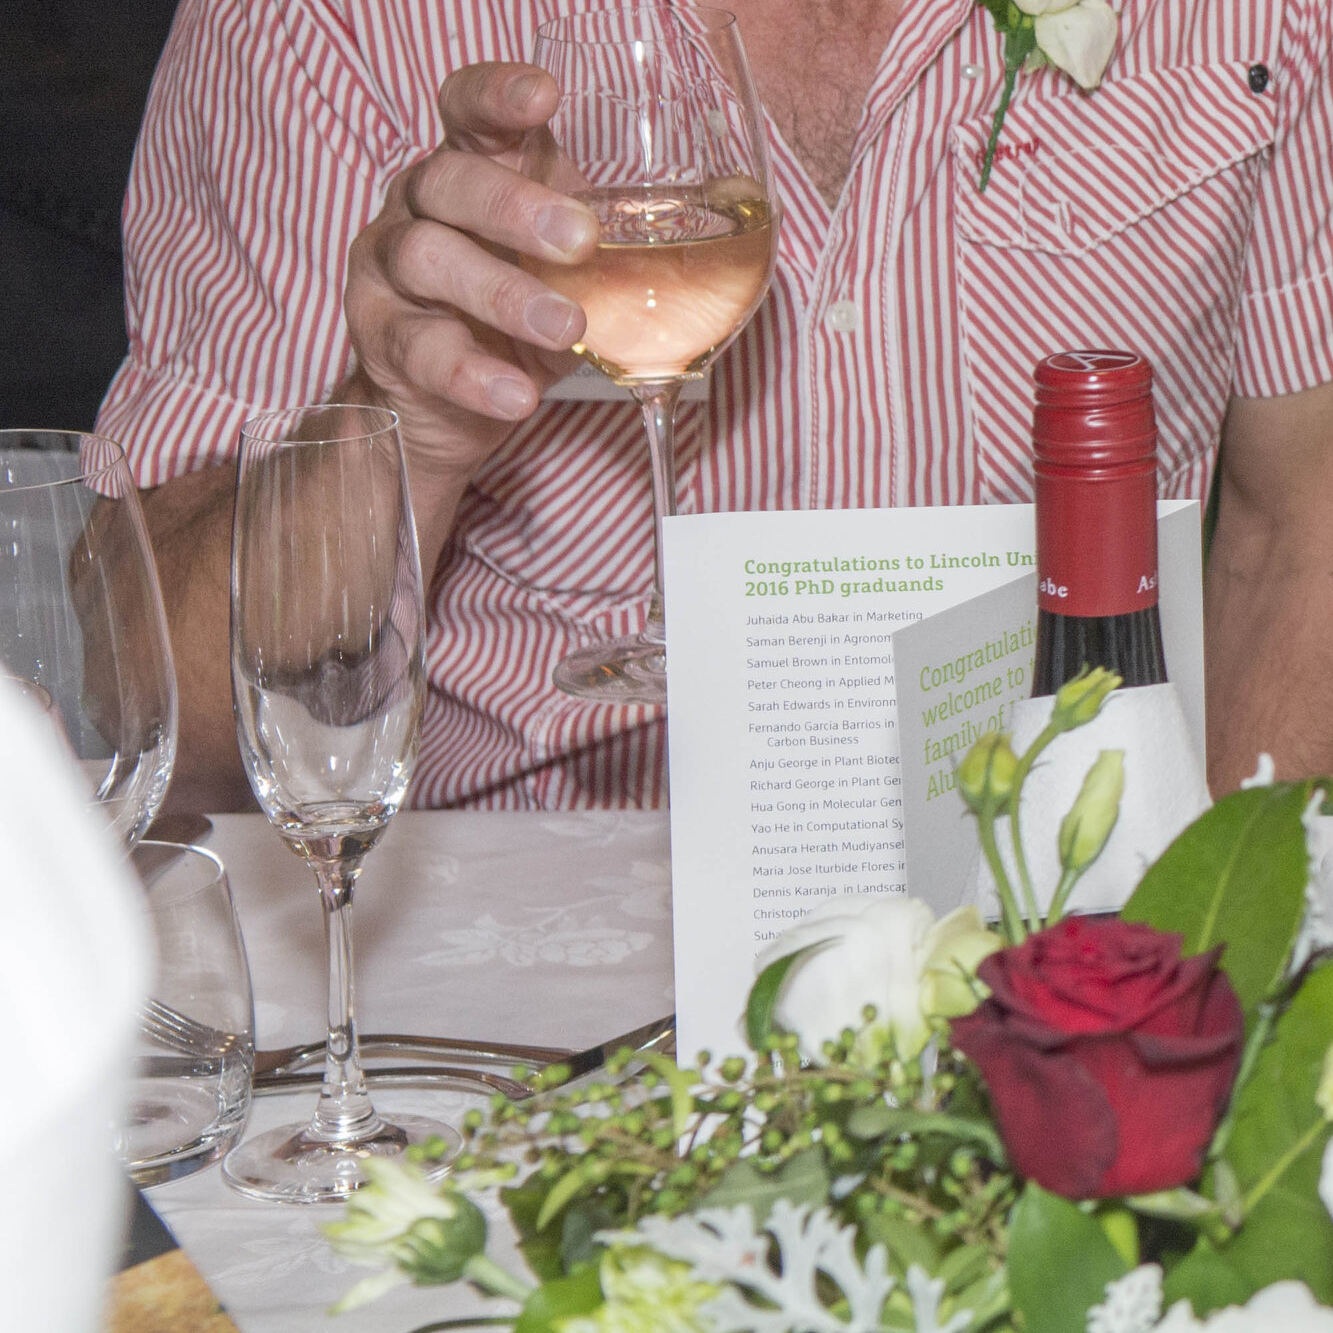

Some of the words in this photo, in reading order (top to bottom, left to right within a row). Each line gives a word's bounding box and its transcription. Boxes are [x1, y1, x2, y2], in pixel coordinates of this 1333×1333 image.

[744, 555, 900, 577] Congratulations
[906, 554, 924, 570] to
[930, 552, 1000, 569] Lincoln
[745, 581, 789, 596] 2016
[795, 579, 834, 595] PhD
[840, 576, 944, 597] graduands
[746, 615, 789, 626] Juhaida
[792, 614, 814, 624] Abu
[817, 612, 849, 623] Bakar
[853, 612, 863, 622] in
[866, 610, 923, 622] Marketing
[746, 636, 785, 647] Saman
[788, 635, 827, 647] Berenji
[830, 634, 840, 645] in
[746, 658, 789, 669] Samuel
[792, 656, 828, 667] Brown
[831, 655, 841, 666] in
[747, 679, 777, 690] Peter
[780, 677, 822, 690] Cheong
[825, 676, 836, 687] in
[839, 675, 881, 689] Applied
[921, 676, 1002, 728] welcome
[1007, 666, 1025, 689] to
[748, 701, 780, 712] Sarah
[783, 699, 831, 711] Edwards
[834, 698, 844, 708] in
[748, 722, 801, 733] Fernando
[804, 720, 839, 731] Garcia
[842, 719, 881, 730] Barrios
[884, 718, 895, 729] in
[767, 736, 806, 747] Carbon
[810, 735, 859, 746] Business
[924, 719, 984, 766] family
[987, 703, 1005, 732] of
[749, 759, 775, 771] Anju
[778, 757, 818, 770] George
[821, 756, 831, 767] in
[834, 755, 864, 766] Plant
[750, 779, 792, 791] Richard
[795, 778, 835, 790] George
[838, 777, 848, 787] in
[851, 776, 880, 787] Plant
[751, 801, 773, 812] Hua
[776, 801, 806, 813] Gong
[809, 799, 819, 810] in
[823, 798, 877, 809] Molecular
[751, 824, 772, 835] Yao
[775, 823, 790, 833] He
[793, 821, 803, 832] in
[806, 819, 888, 832] Computational
[752, 845, 798, 856] Anusara
[801, 842, 838, 854] Herath
[753, 865, 784, 876] Maria
[787, 865, 812, 875] Jose
[815, 862, 858, 874] Iturbide
[861, 861, 895, 872] Flores
[753, 886, 791, 898] Dennis
[794, 885, 837, 898] Karanja
[843, 884, 853, 894] in
